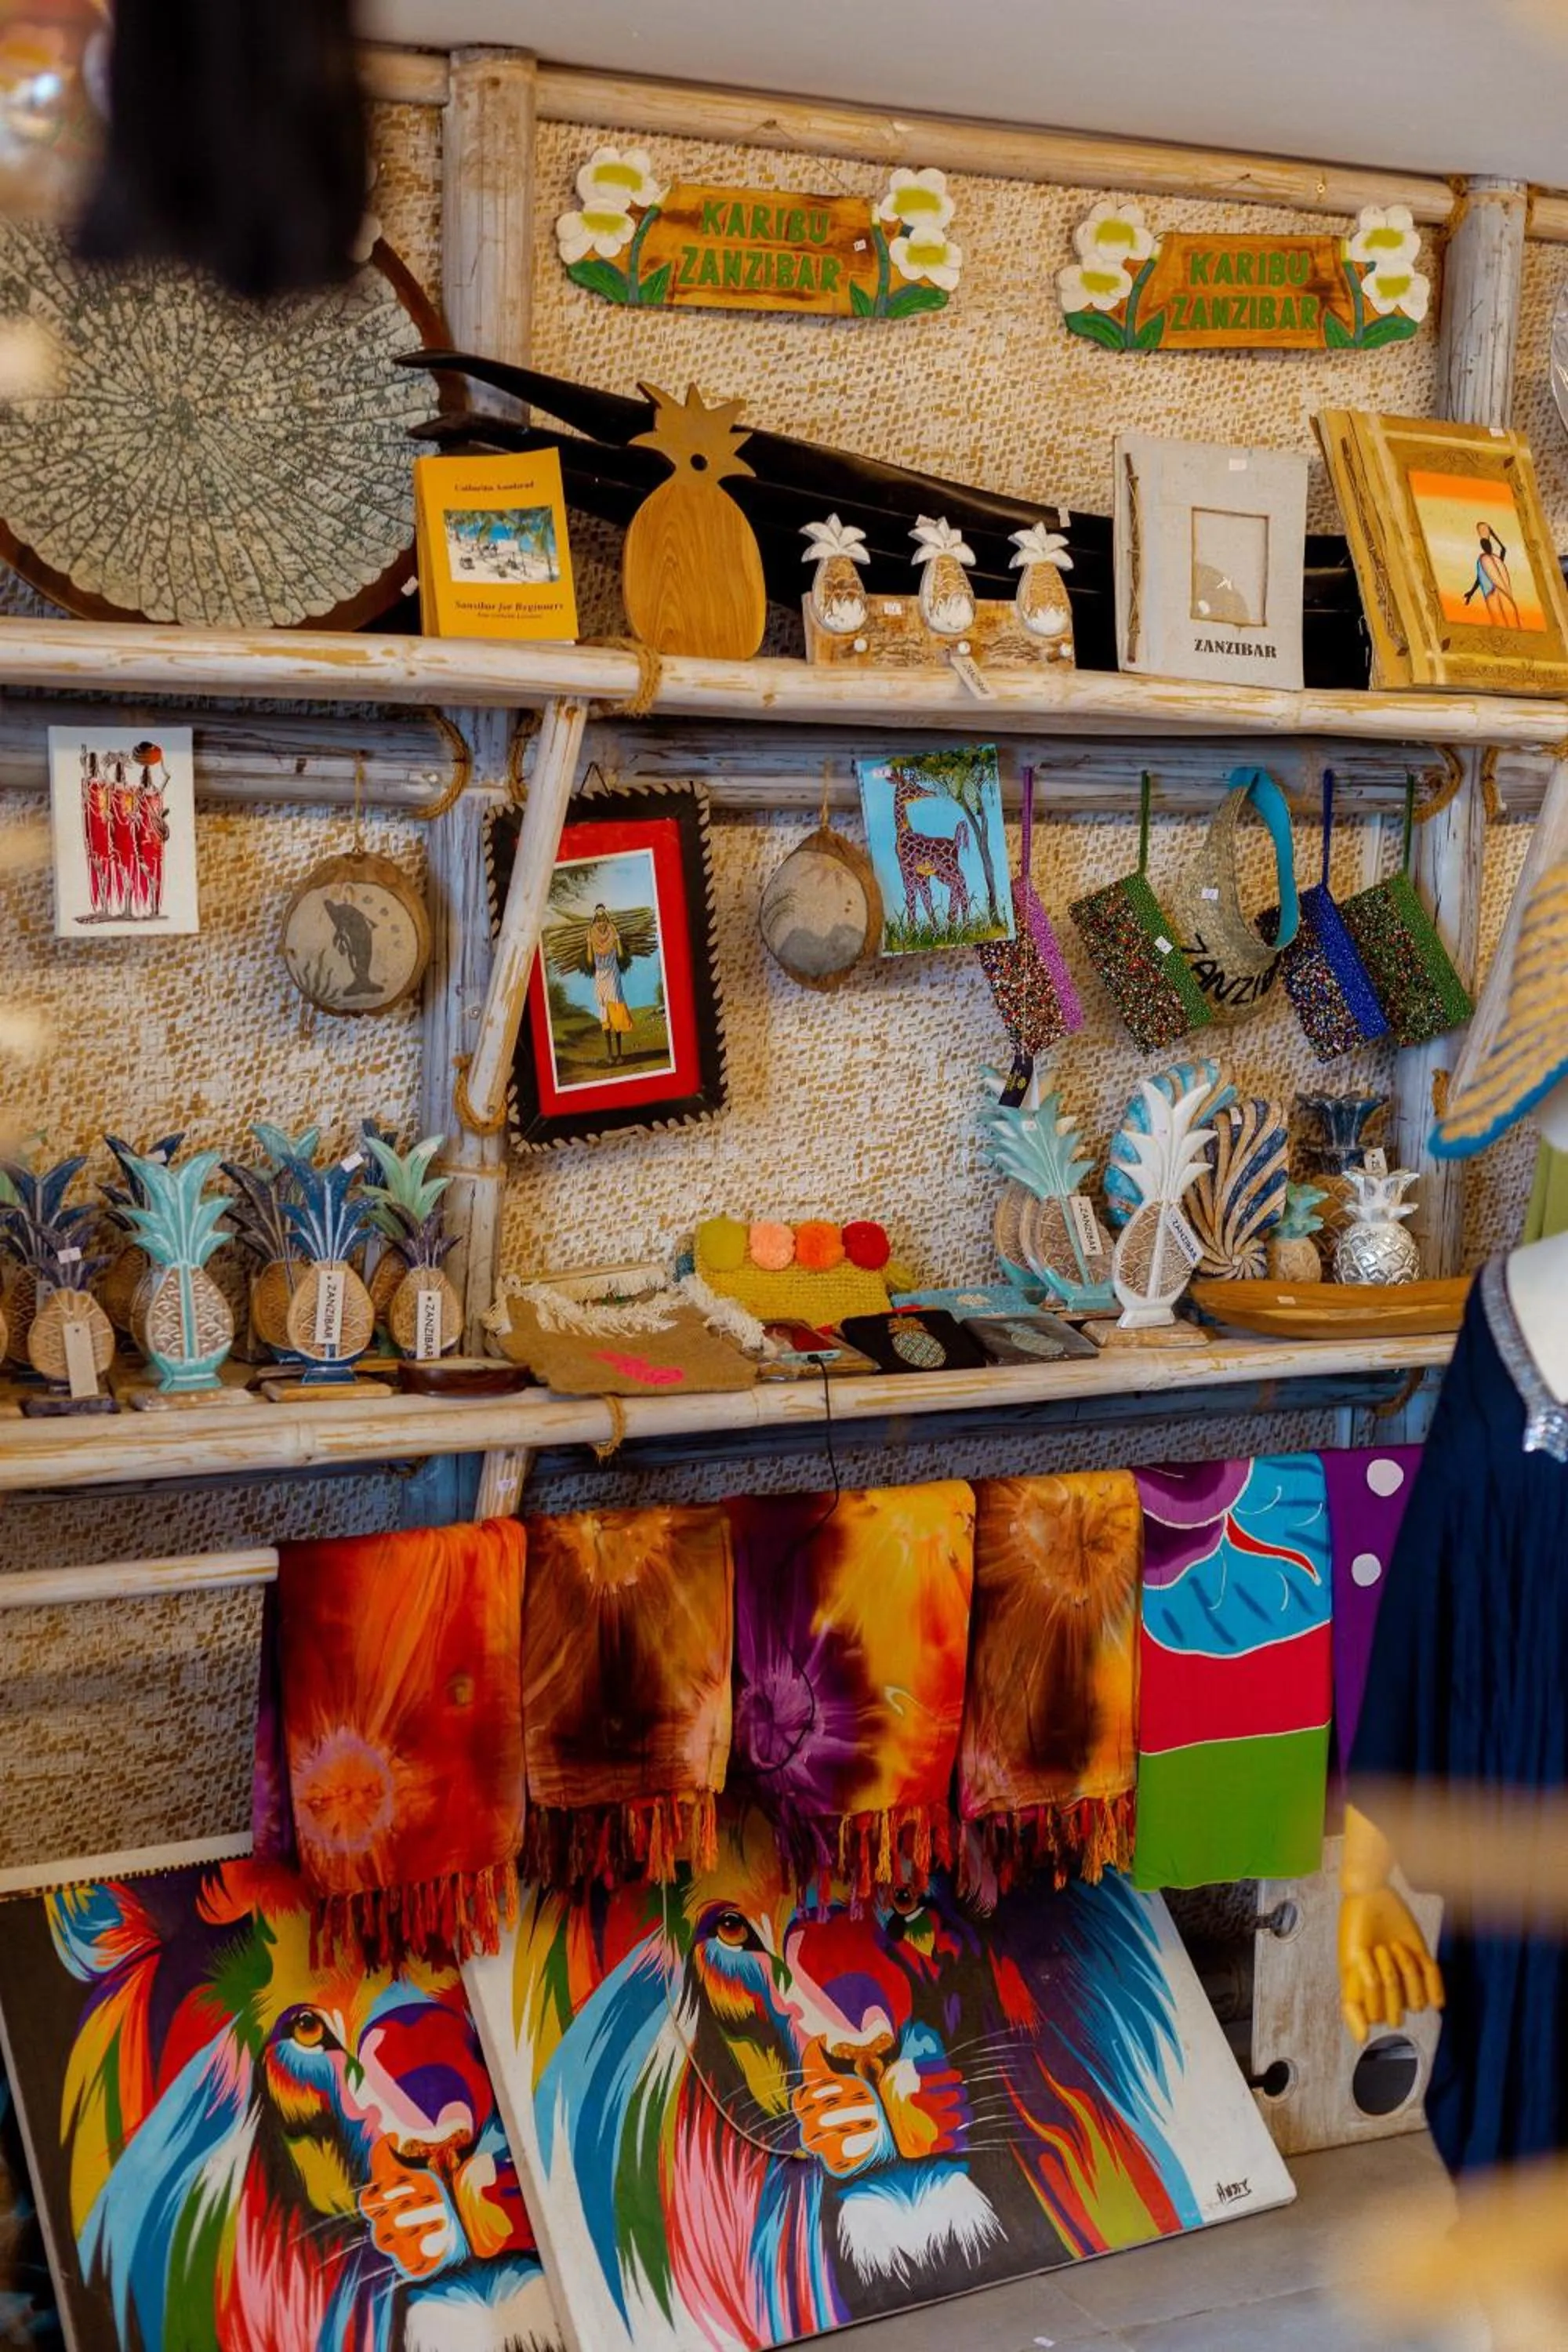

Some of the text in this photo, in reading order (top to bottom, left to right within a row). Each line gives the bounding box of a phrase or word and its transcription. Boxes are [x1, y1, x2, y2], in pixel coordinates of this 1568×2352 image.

[702, 200, 829, 245] KARIBU
[678, 245, 844, 294] ZANZIBAR
[1189, 251, 1310, 287] KARIBU
[1170, 295, 1321, 332] ZANZIBAR
[1193, 637, 1278, 659] ZANZIBAR
[323, 1283, 338, 1339] ZANZIBAR
[423, 1304, 435, 1357] ZANZIBAR
